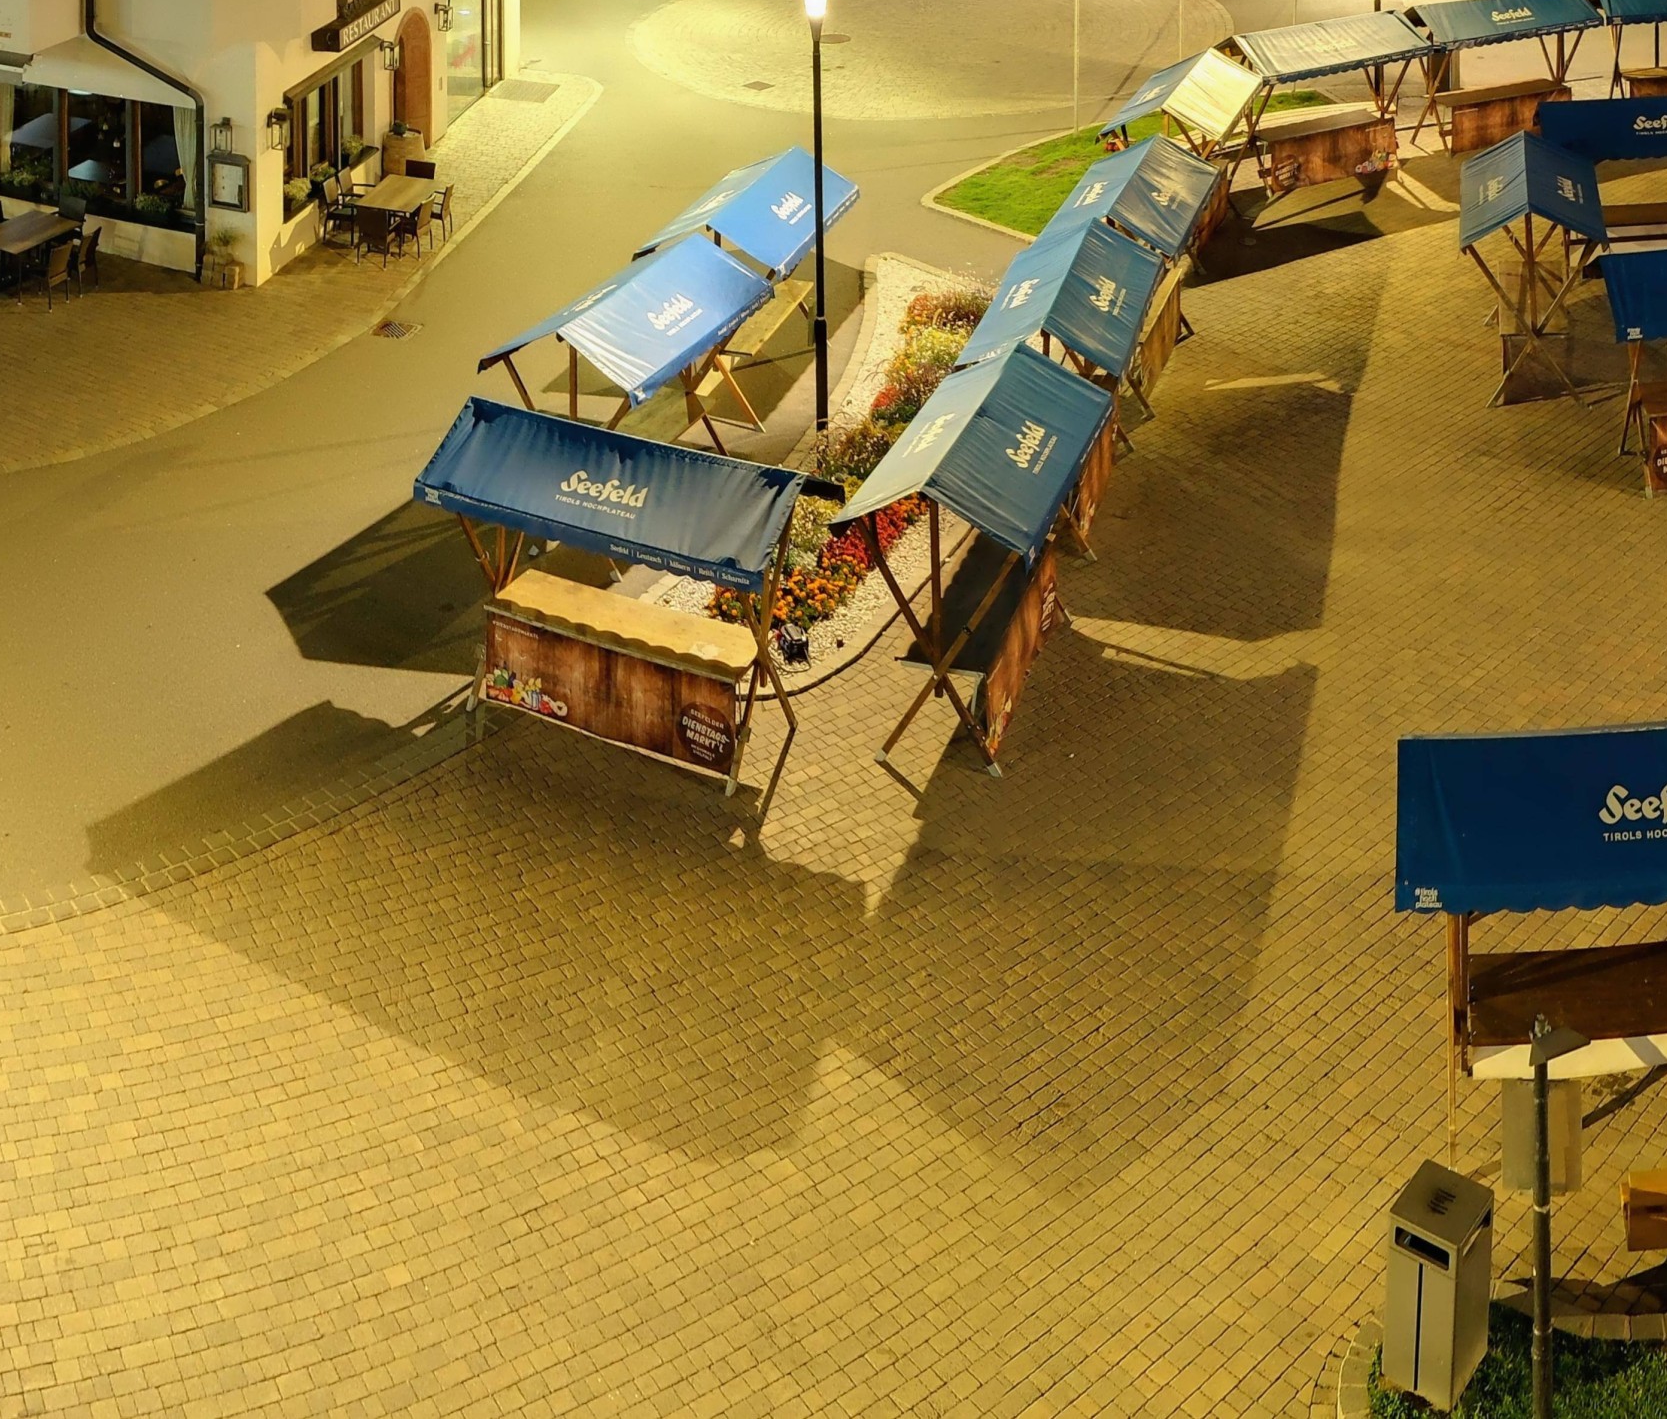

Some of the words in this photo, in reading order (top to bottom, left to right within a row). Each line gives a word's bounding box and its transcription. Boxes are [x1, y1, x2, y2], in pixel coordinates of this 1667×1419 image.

[1491, 6, 1533, 22] Seefeld
[647, 293, 694, 330] Seefeld
[1005, 420, 1046, 469] Seefeld
[561, 469, 648, 508] Seefeld
[555, 493, 581, 506] TIROLS
[582, 500, 636, 520] HOCHPLATEAU
[1603, 830, 1643, 842] TIROLS
